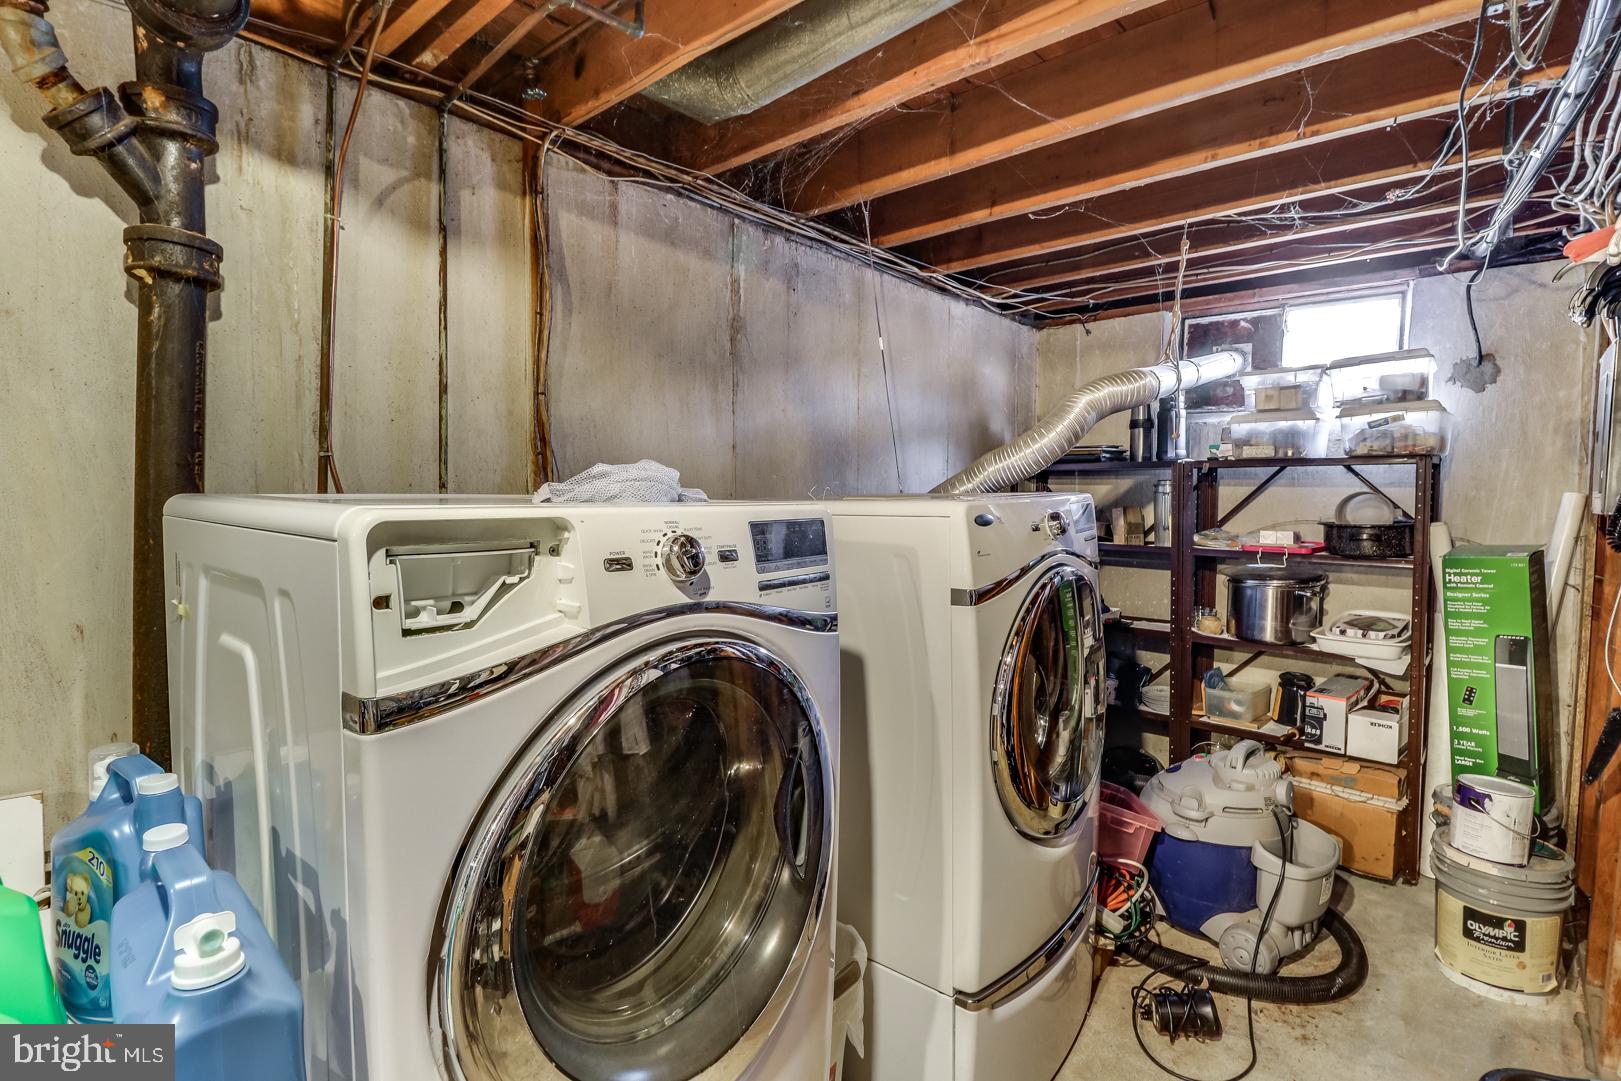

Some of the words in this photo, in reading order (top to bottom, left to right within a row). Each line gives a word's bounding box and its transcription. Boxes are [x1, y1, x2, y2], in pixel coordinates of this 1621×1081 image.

[1446, 574, 1482, 582] Heater
[1369, 721, 1393, 730] KOHLER
[87, 850, 106, 877] 210
[1467, 920, 1520, 941] OLYMPIC
[1472, 931, 1515, 948] Premium
[55, 918, 102, 965] Snuggle
